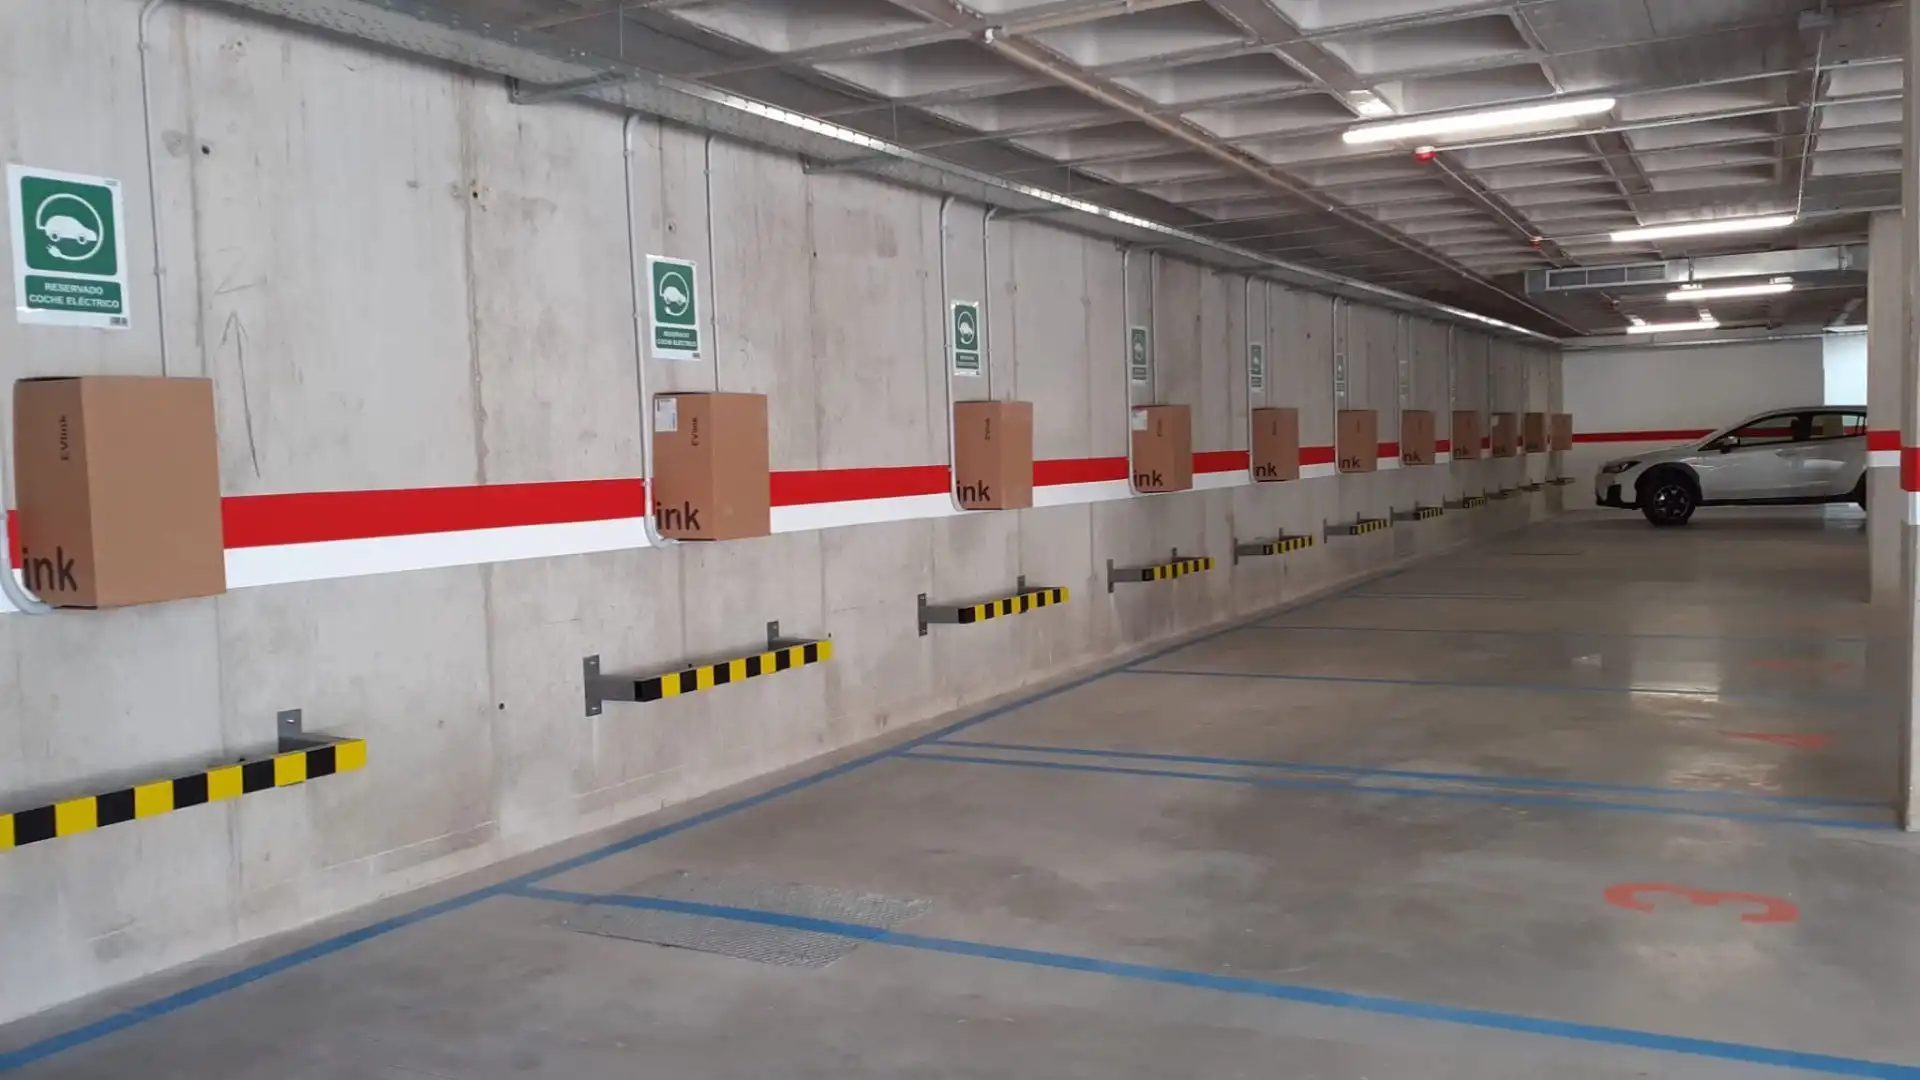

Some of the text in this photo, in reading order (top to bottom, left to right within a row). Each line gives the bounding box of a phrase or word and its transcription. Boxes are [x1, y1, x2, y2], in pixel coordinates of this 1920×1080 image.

[29, 294, 64, 304] COCHE
[44, 282, 104, 295] RESERVADO
[1254, 462, 1277, 477] nk
[656, 501, 700, 530] ink
[22, 546, 78, 592] ink
[1603, 882, 1801, 925] 3
